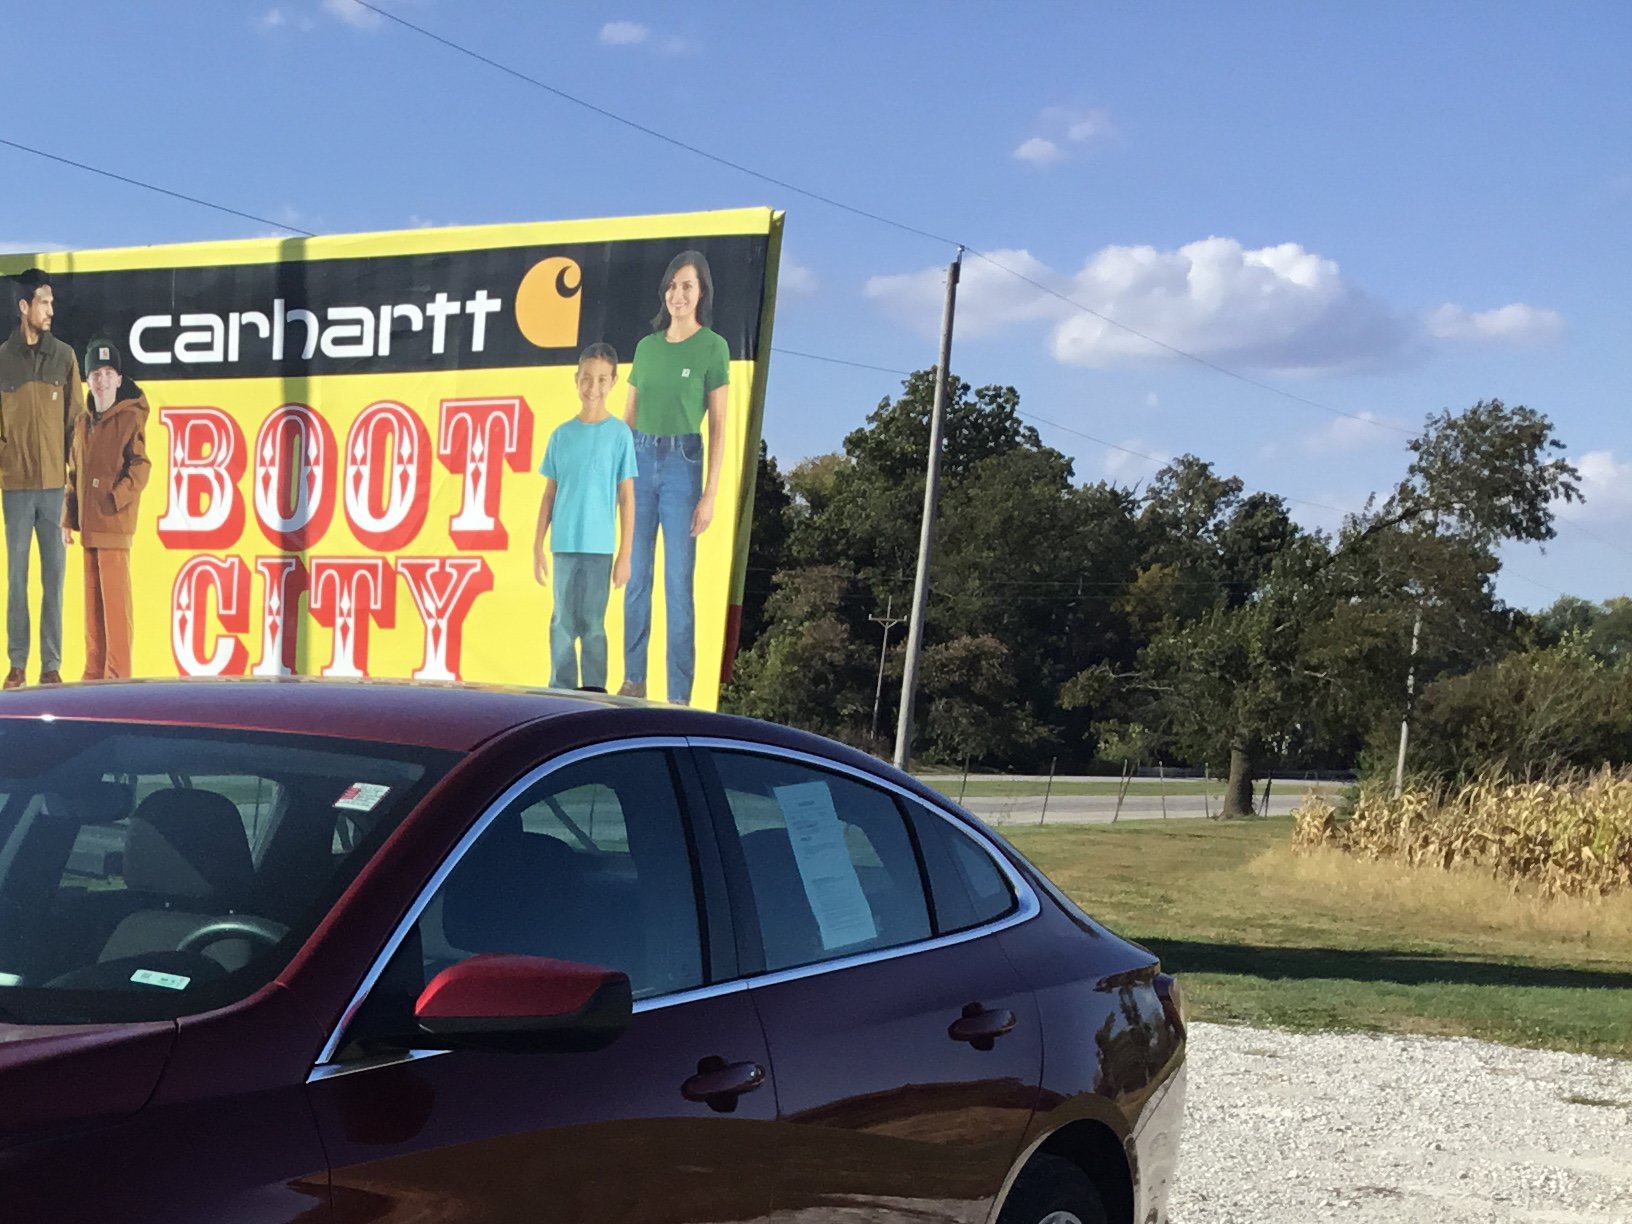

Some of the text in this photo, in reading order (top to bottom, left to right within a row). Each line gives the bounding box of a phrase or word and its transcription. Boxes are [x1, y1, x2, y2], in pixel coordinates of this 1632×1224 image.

[128, 289, 502, 365] carhartt
[156, 395, 535, 552] BOOT
[170, 553, 495, 682] CITY
